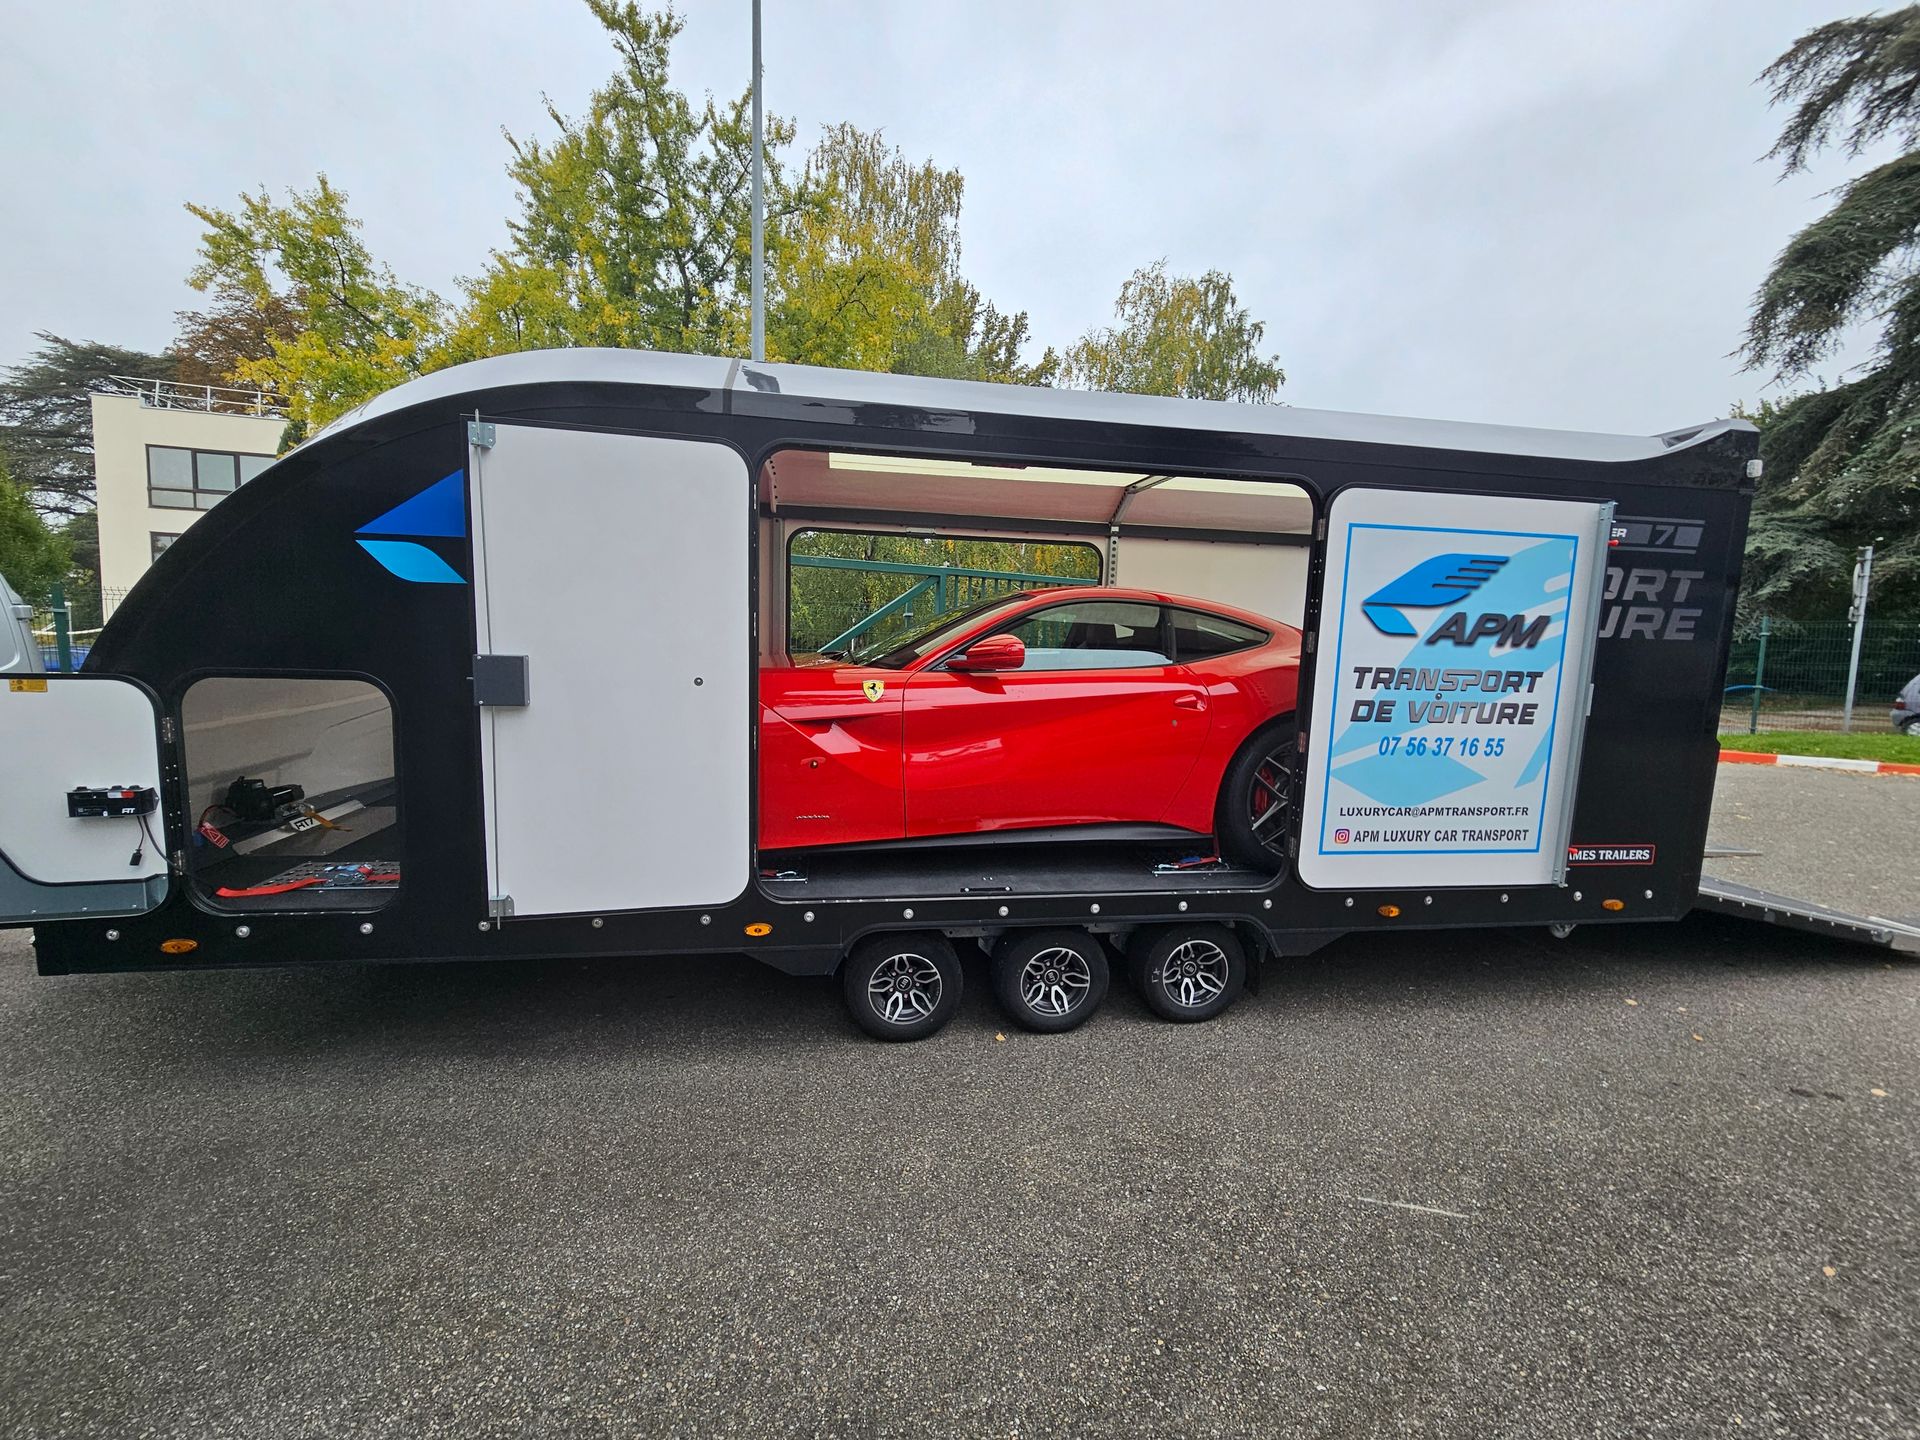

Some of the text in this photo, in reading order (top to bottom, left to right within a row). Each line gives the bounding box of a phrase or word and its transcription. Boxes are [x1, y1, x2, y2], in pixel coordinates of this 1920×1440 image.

[1655, 524, 1677, 545] 7
[1425, 612, 1552, 649] APM
[1353, 666, 1544, 694] TRANSPORT
[1350, 700, 1539, 725] DE VOITURE
[1378, 736, 1505, 757] 07 56 37 16 55
[1339, 806, 1529, 818] LUXURYCAR@APMTRANSPORT.FR
[1353, 829, 1529, 843] APM LUXURY CAR TRANSPORT
[1598, 849, 1650, 860] TRAILERS
